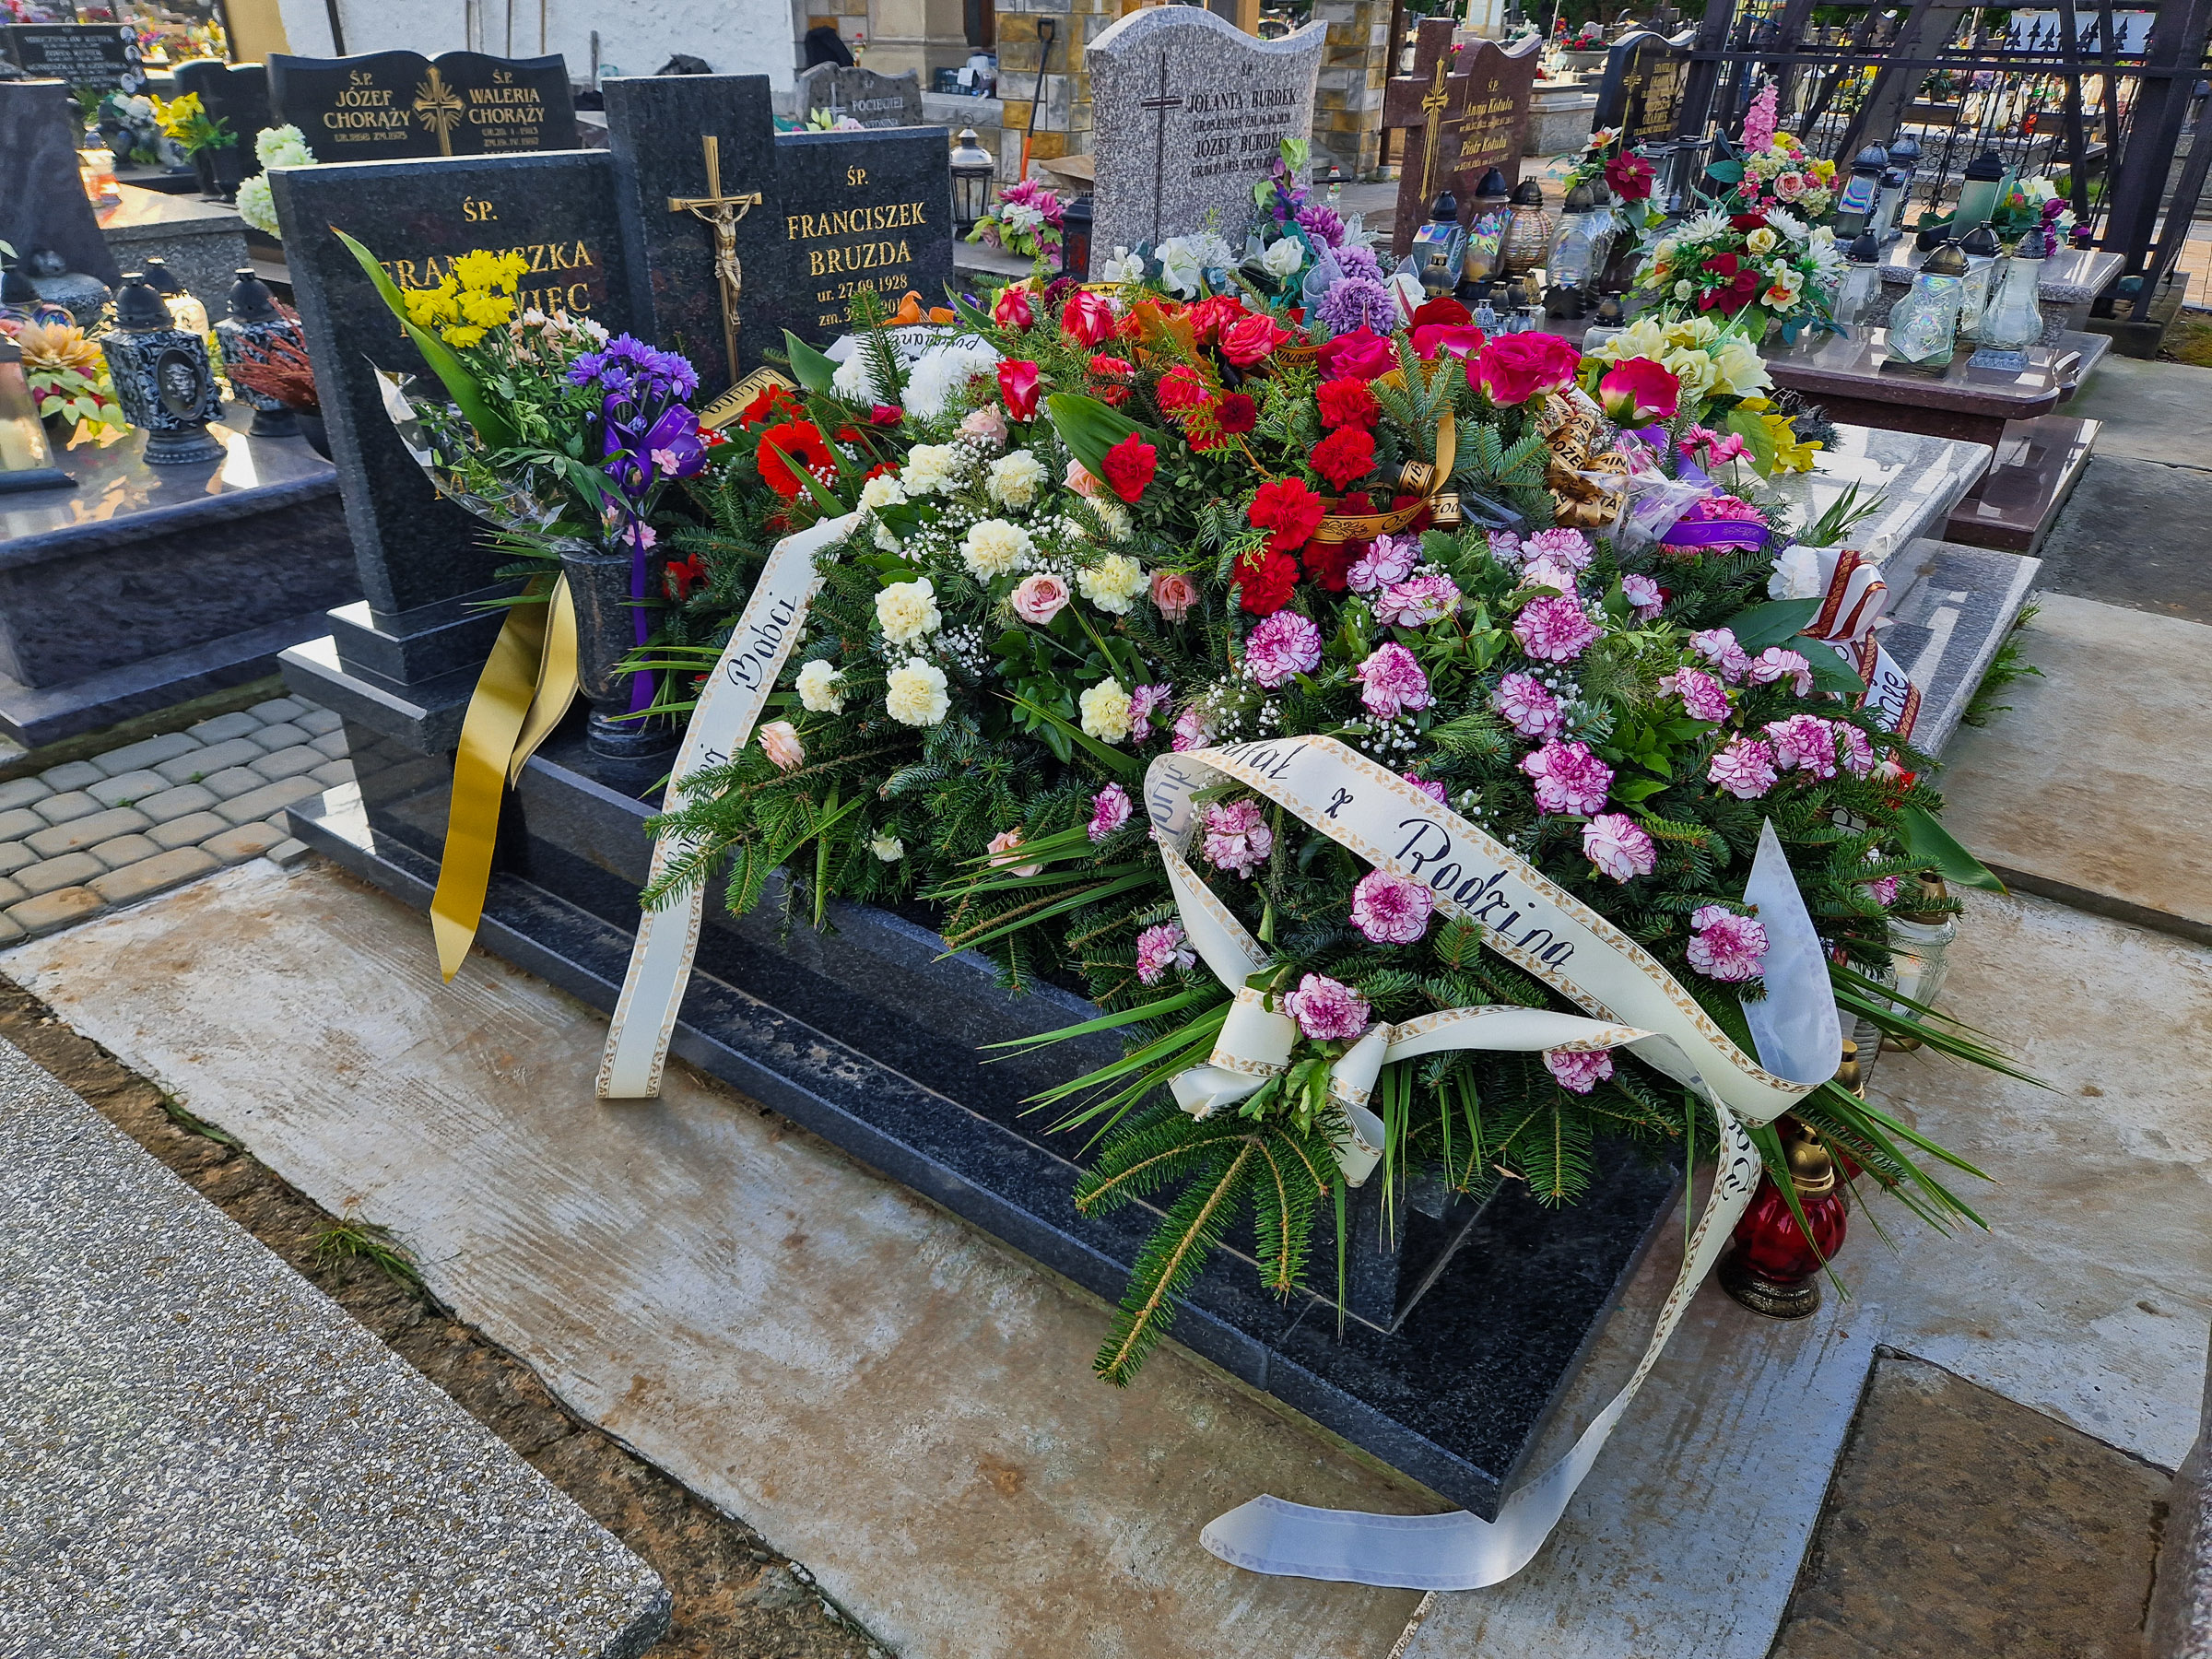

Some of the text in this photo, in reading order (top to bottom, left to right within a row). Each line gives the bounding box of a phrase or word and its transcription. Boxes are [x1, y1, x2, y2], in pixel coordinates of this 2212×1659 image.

[335, 86, 393, 108] JÓZEF
[468, 88, 541, 104] WALERIA
[1187, 88, 1297, 113] JOLANTA BURDEK
[324, 107, 411, 130] CHORĄŻY
[468, 104, 546, 124] CHORĄŻY
[1194, 135, 1233, 158] JÓZEF
[847, 165, 869, 185] ŚP.
[462, 196, 498, 222] ŚP.
[786, 202, 927, 240] FRANCISZEK
[809, 240, 912, 276] BRUZDA
[726, 591, 797, 692] Babci
